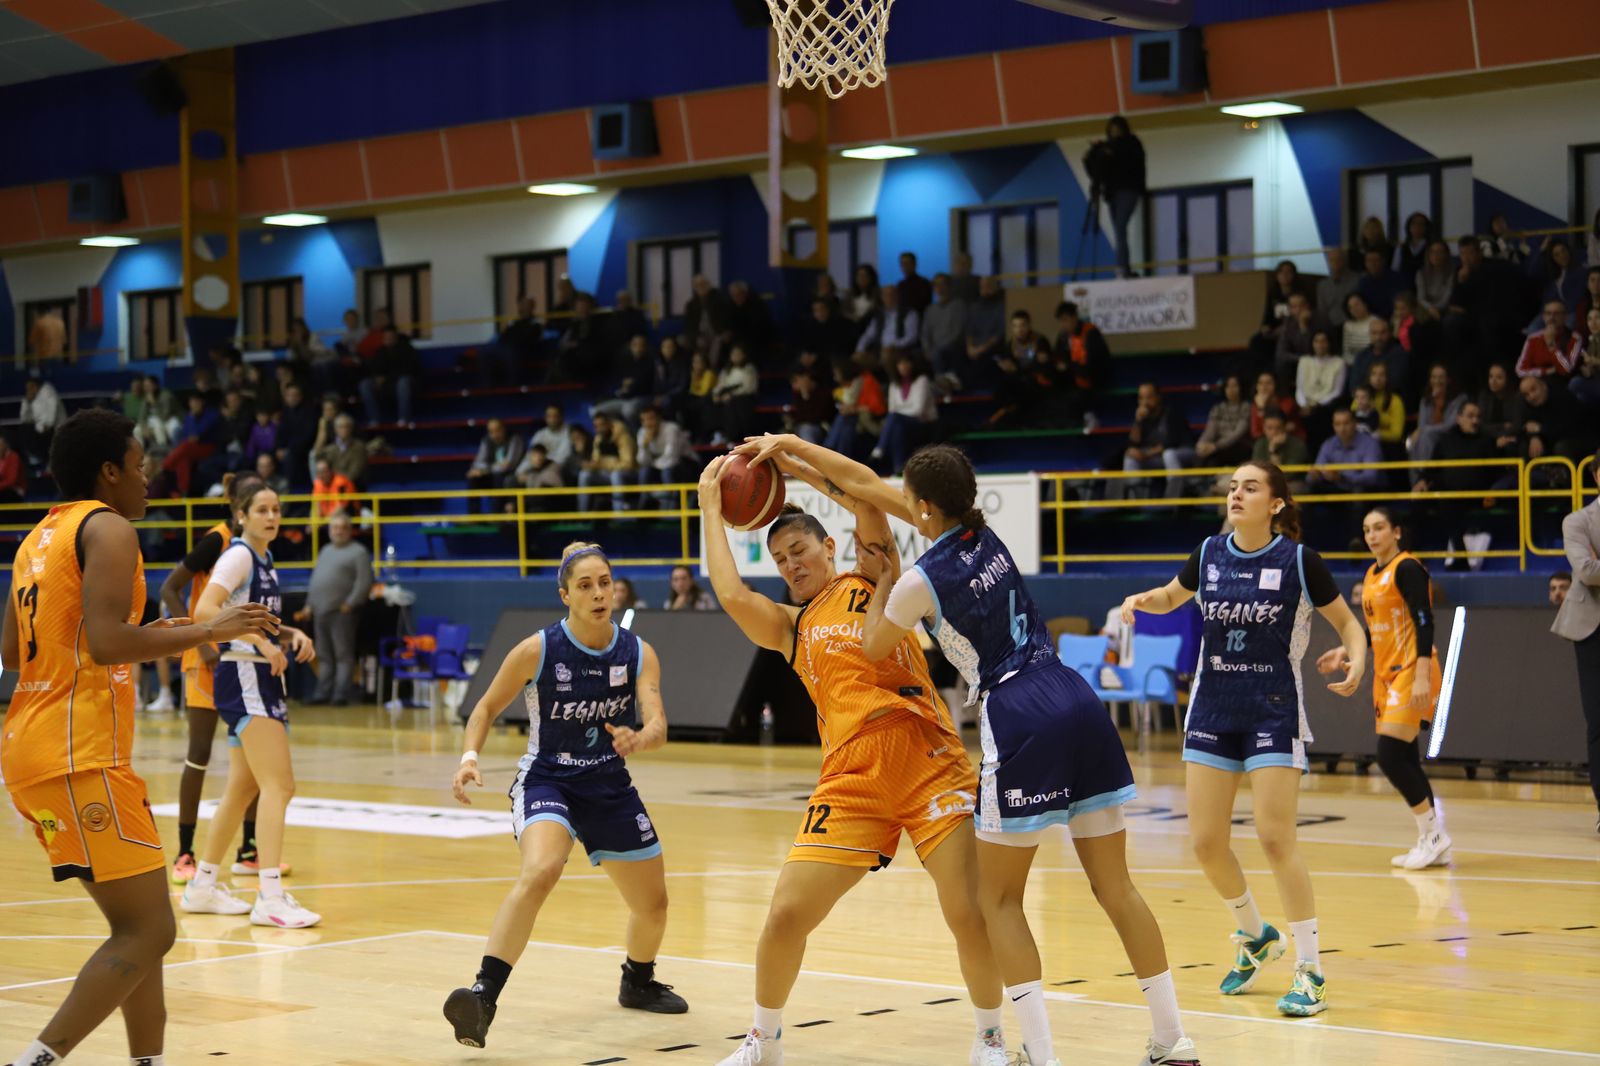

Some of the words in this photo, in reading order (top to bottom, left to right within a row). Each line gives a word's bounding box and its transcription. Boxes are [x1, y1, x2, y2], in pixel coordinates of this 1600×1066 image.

[1117, 308, 1187, 329] ZAMORA
[847, 588, 871, 614] 12
[1203, 600, 1284, 626] LEGANÉS
[811, 621, 863, 644] Recole
[1008, 589, 1029, 652] 6
[1226, 629, 1248, 652] 18
[550, 694, 632, 724] LEGANÉS
[585, 726, 600, 748] 9
[802, 804, 830, 835] 12
